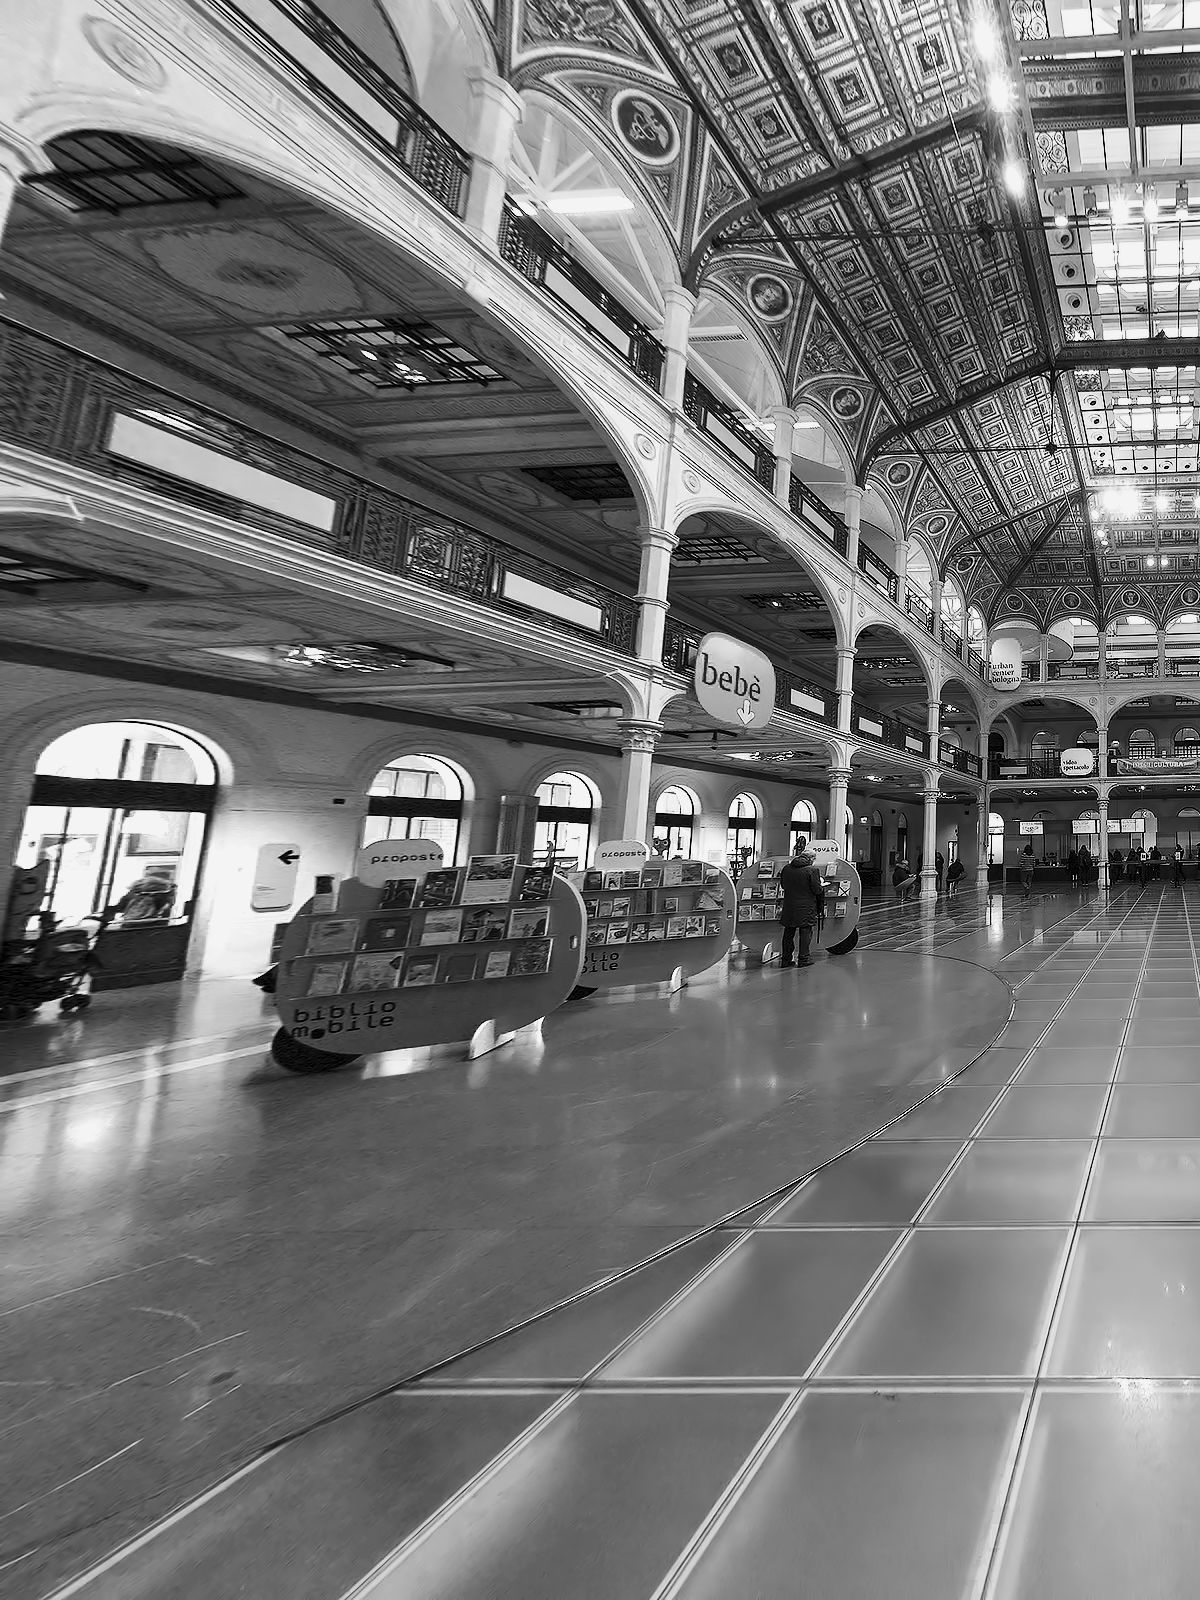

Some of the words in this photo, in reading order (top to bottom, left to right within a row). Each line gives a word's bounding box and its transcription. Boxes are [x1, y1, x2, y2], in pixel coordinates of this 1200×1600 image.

[992, 662, 1014, 670] urban
[702, 652, 761, 702] bebè
[992, 676, 1020, 684] bologna
[1062, 764, 1090, 772] spettacolo
[370, 852, 444, 865] proposte
[601, 850, 647, 859] proposte
[293, 1000, 397, 1023] biblio
